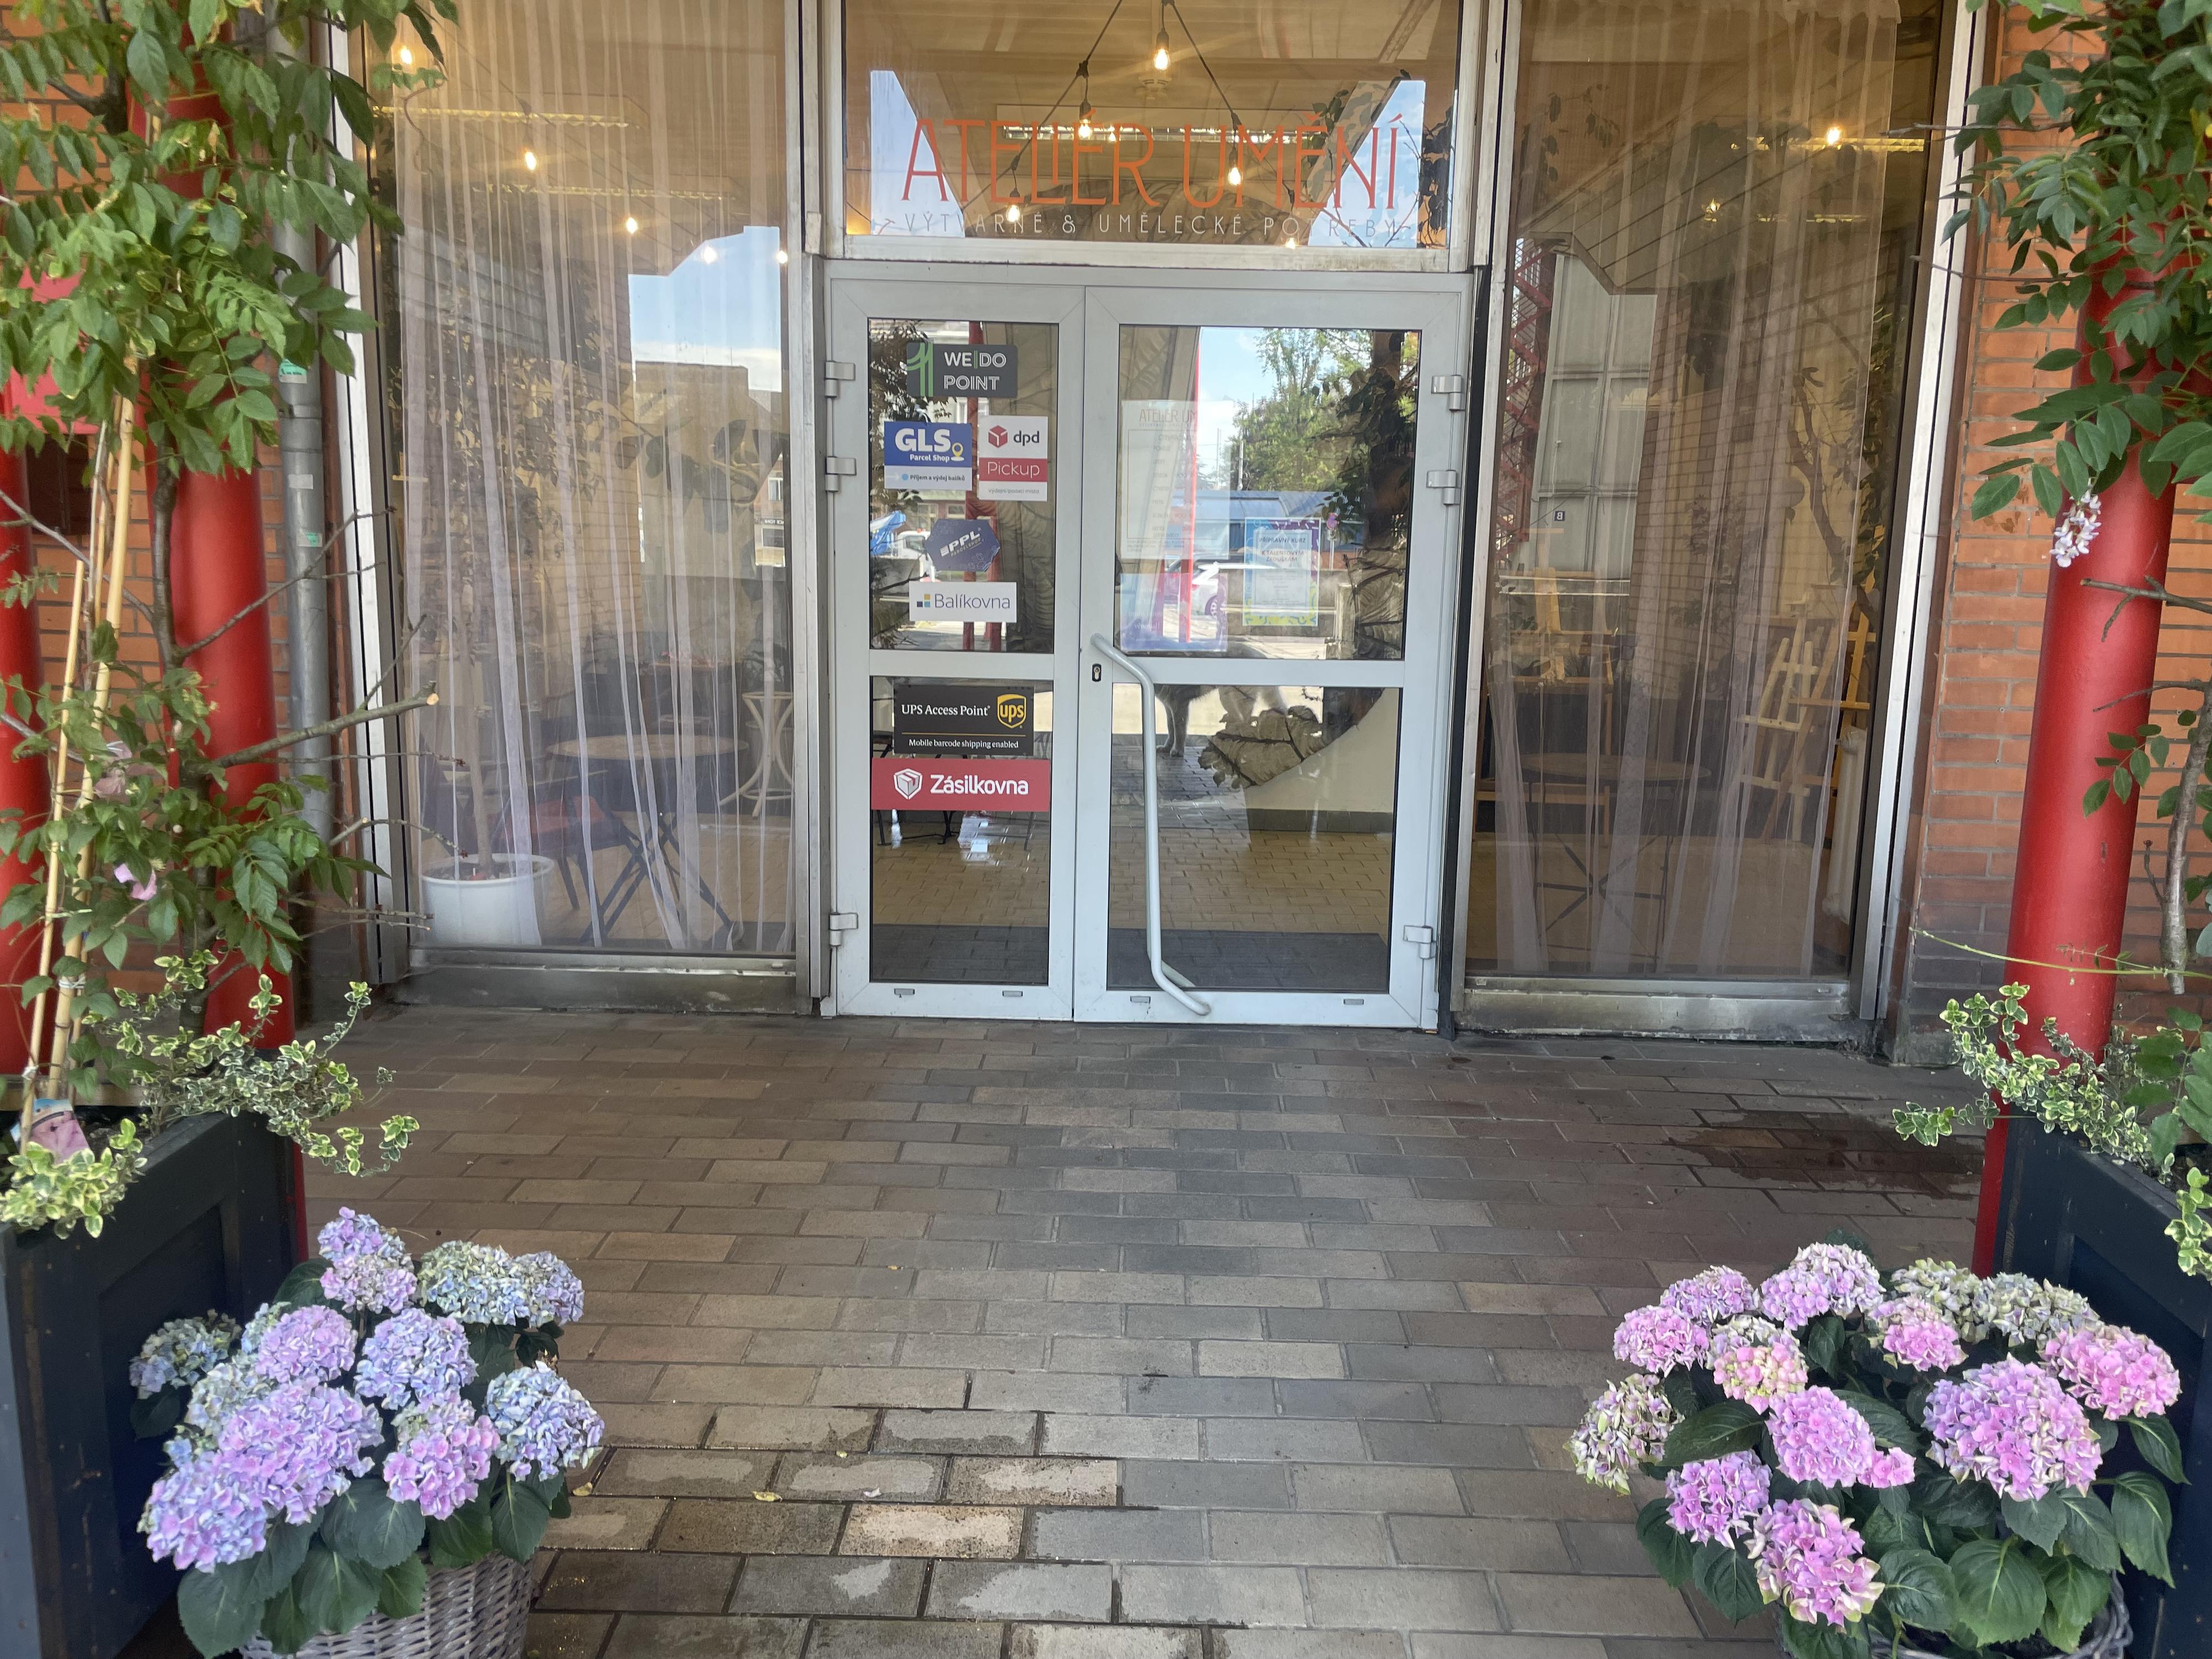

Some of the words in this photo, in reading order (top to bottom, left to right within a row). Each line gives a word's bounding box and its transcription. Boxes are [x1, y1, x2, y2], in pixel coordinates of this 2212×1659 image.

[901, 108, 1160, 206] ATELIÉR
[1183, 113, 1402, 210] UMĚNÍ
[905, 211, 1042, 233] VÝTVARNÉ
[1062, 215, 1076, 233] &
[1099, 212, 1241, 235] UMĚLECKÉ
[943, 375, 1000, 391] POINT
[895, 428, 952, 453] GLS
[1013, 430, 1040, 446] dpd
[933, 454, 950, 463] Shop
[987, 461, 1040, 478] Pickup
[948, 530, 980, 552] PPL
[934, 593, 1011, 609] Balíkovna
[901, 704, 923, 715] UPS
[925, 705, 958, 716] Access
[1000, 705, 1024, 723] ups
[909, 739, 933, 747] Mobile
[933, 739, 961, 748] barcode
[961, 740, 991, 749] shipping
[930, 774, 1029, 795] Zásilkovna
